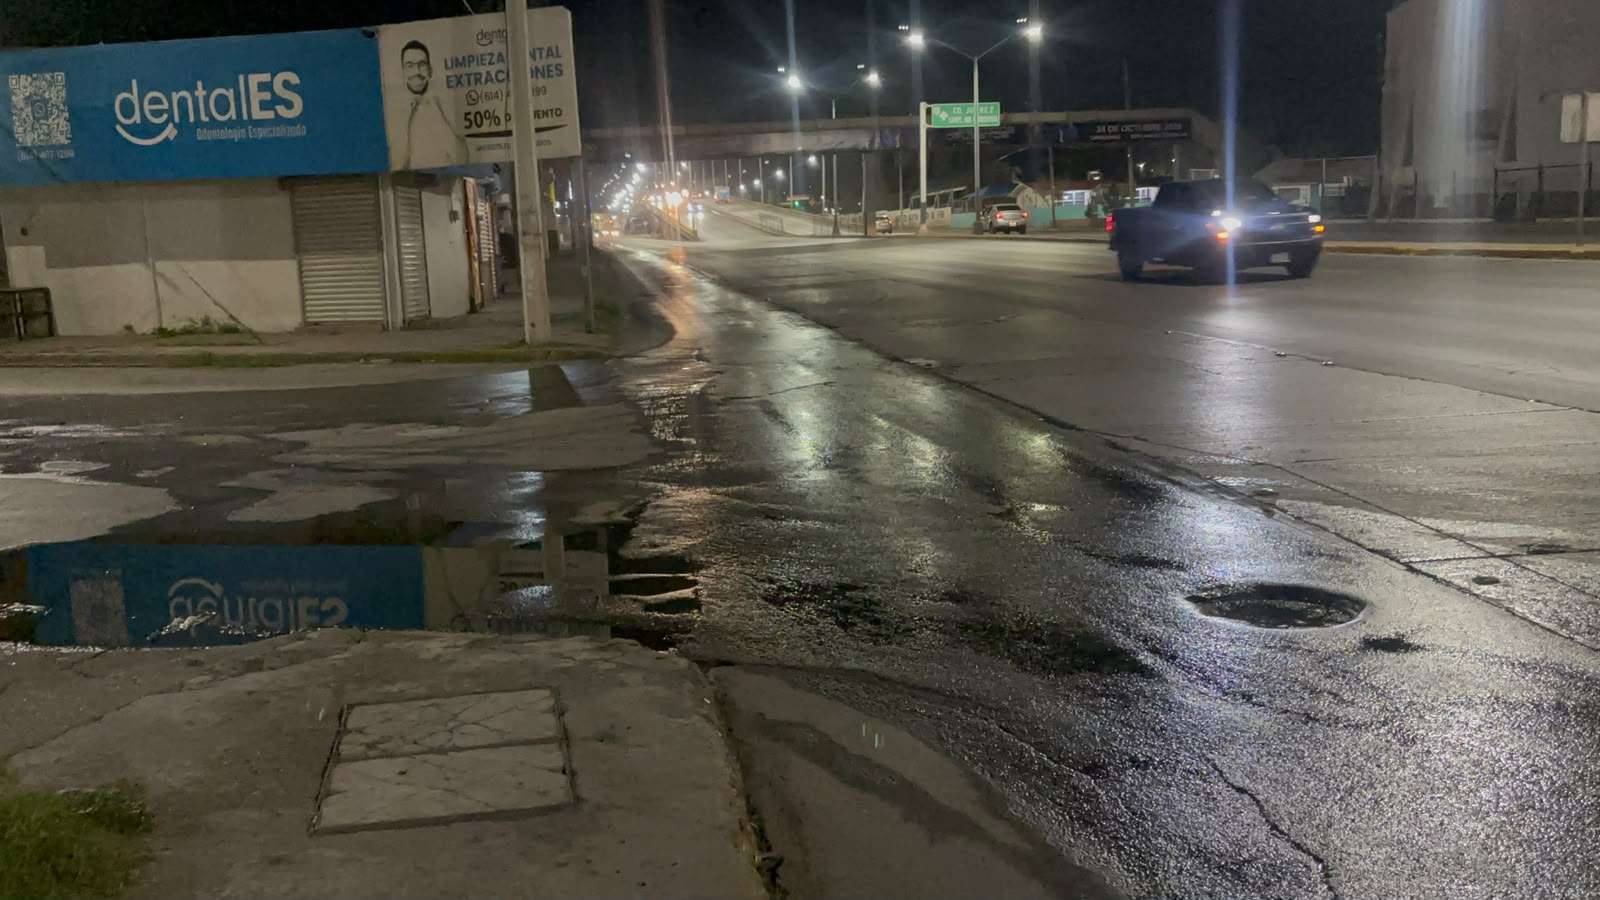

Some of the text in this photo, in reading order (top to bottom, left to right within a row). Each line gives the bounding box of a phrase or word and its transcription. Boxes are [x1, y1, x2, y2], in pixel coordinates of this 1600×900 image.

[444, 51, 506, 70] LIMPIEZA
[114, 71, 305, 125] dentalES
[464, 108, 501, 129] 50%
